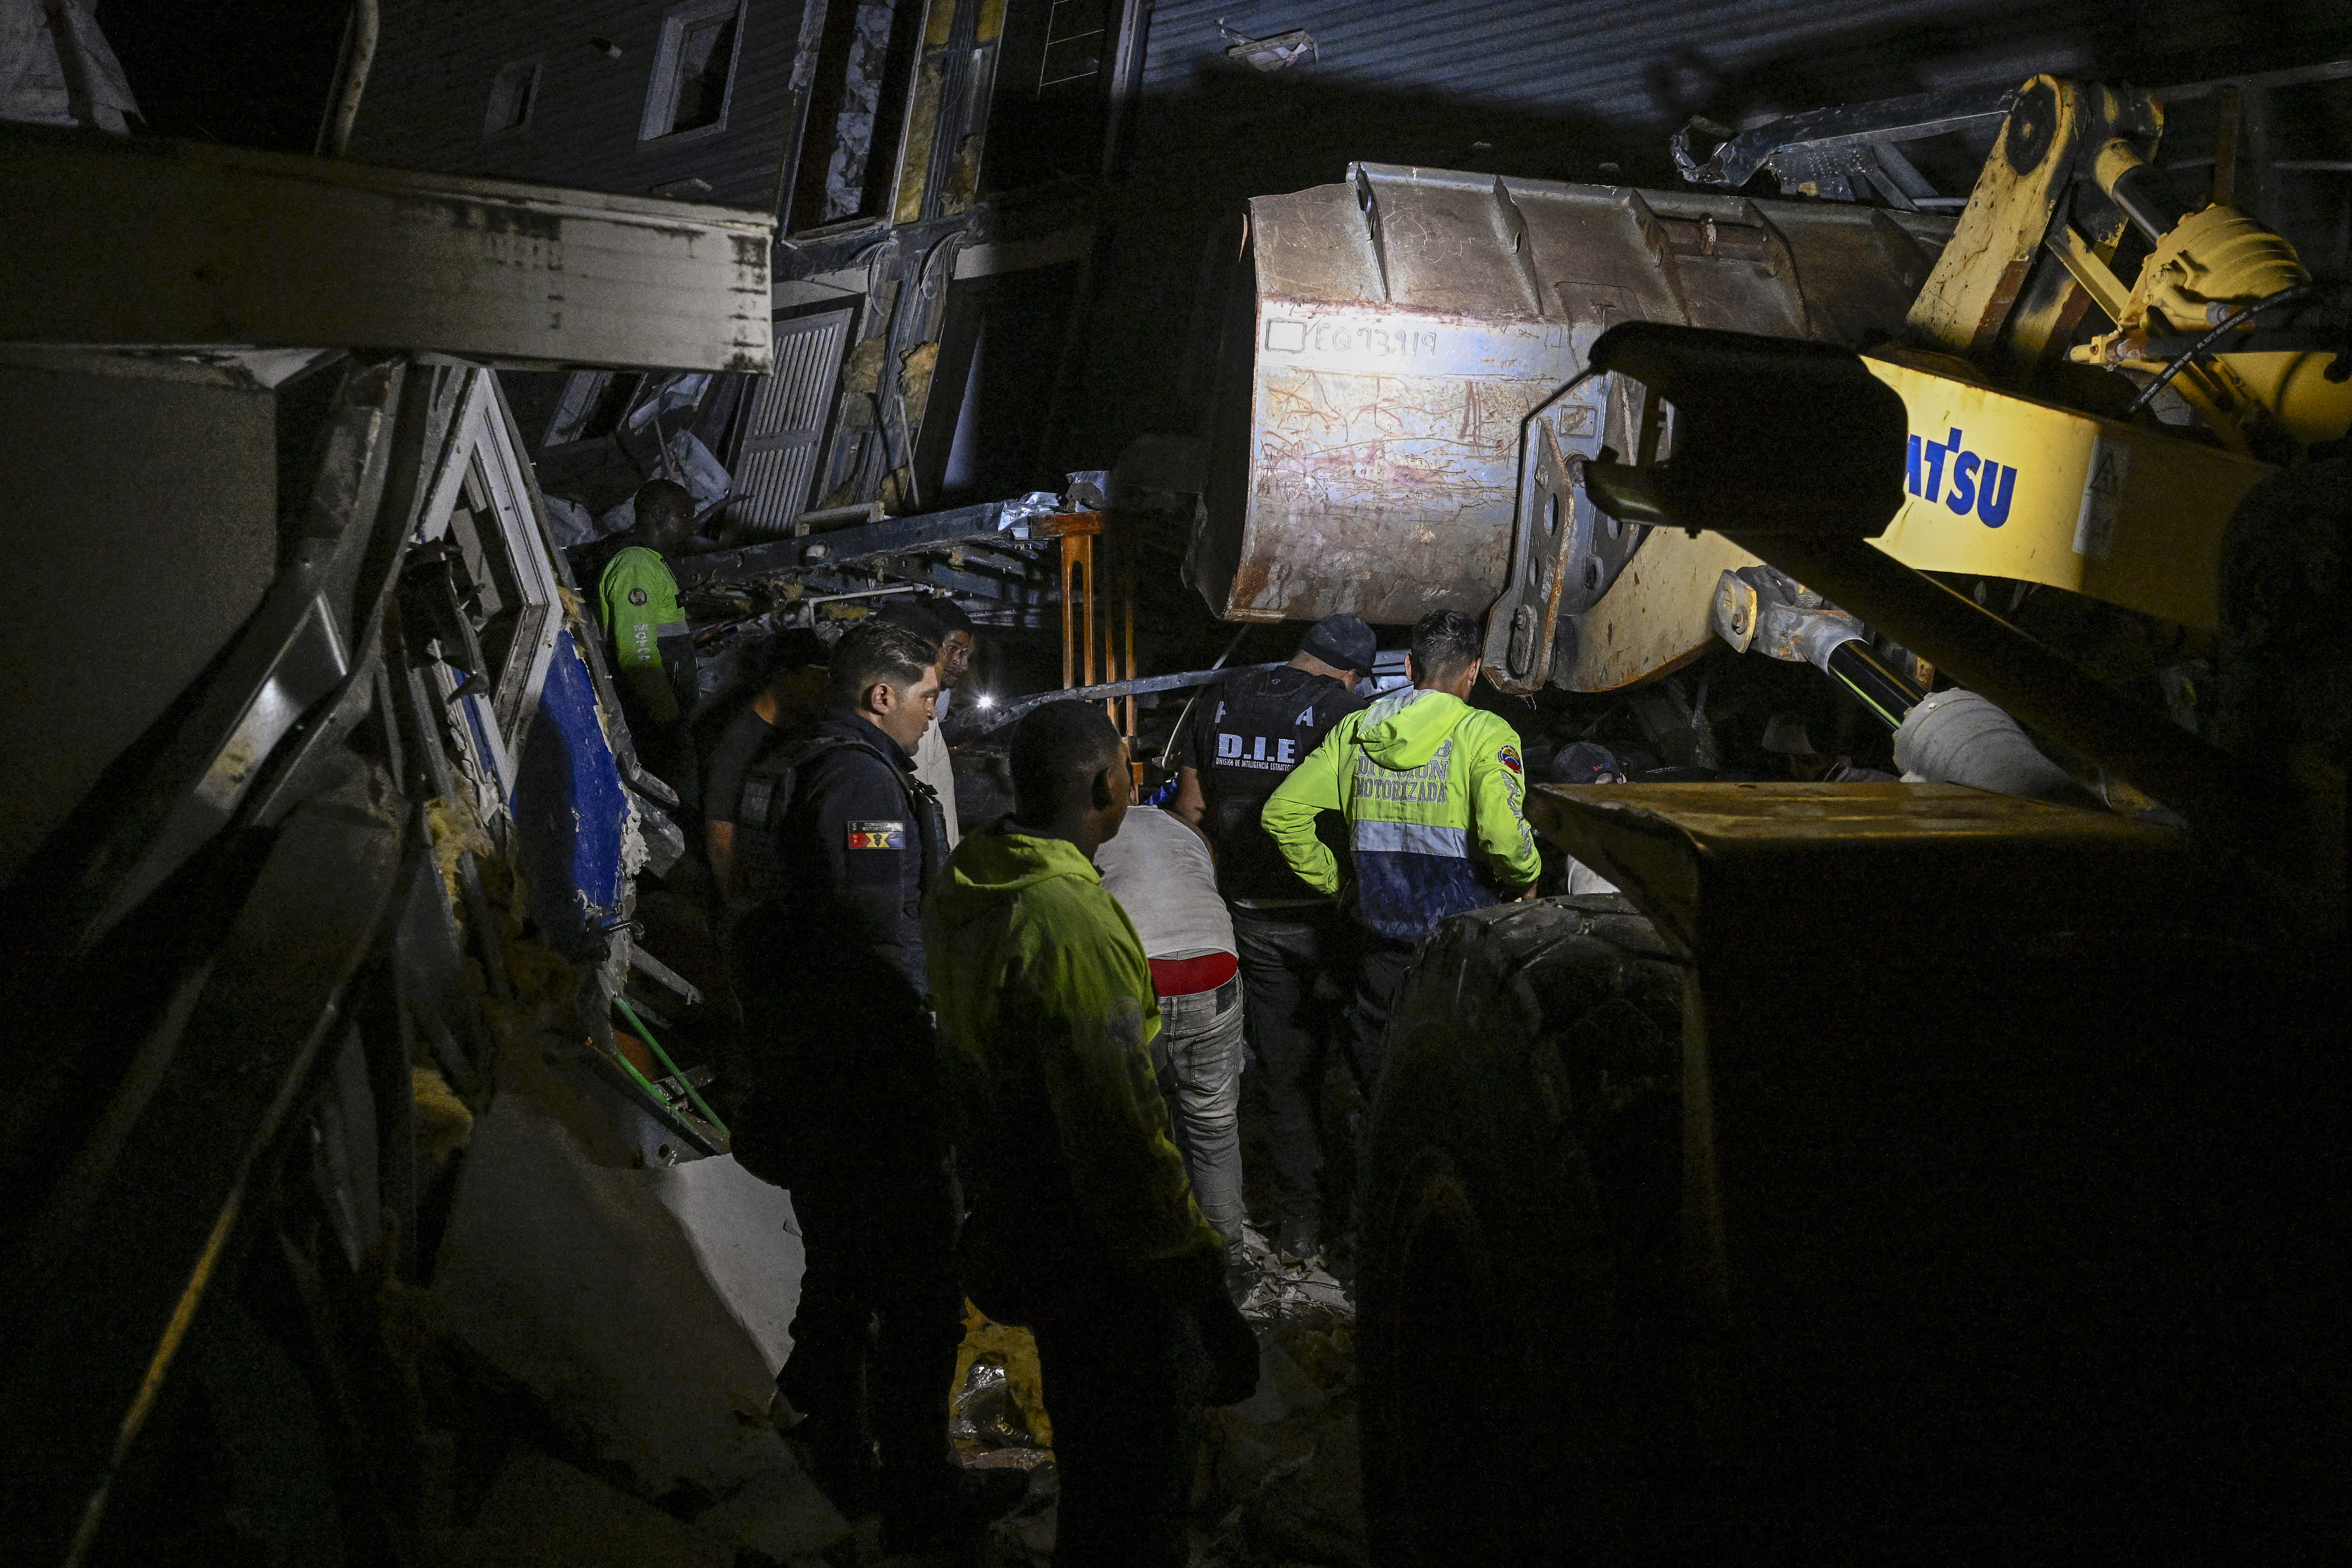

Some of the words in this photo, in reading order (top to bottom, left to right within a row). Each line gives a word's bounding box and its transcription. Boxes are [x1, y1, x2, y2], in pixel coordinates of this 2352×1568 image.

[1906, 427, 2017, 528] ATSU
[1216, 757, 1233, 767] DIVISION
[1241, 760, 1268, 770] INTELIGENCIA
[1356, 777, 1446, 804] MOTORIZADA
